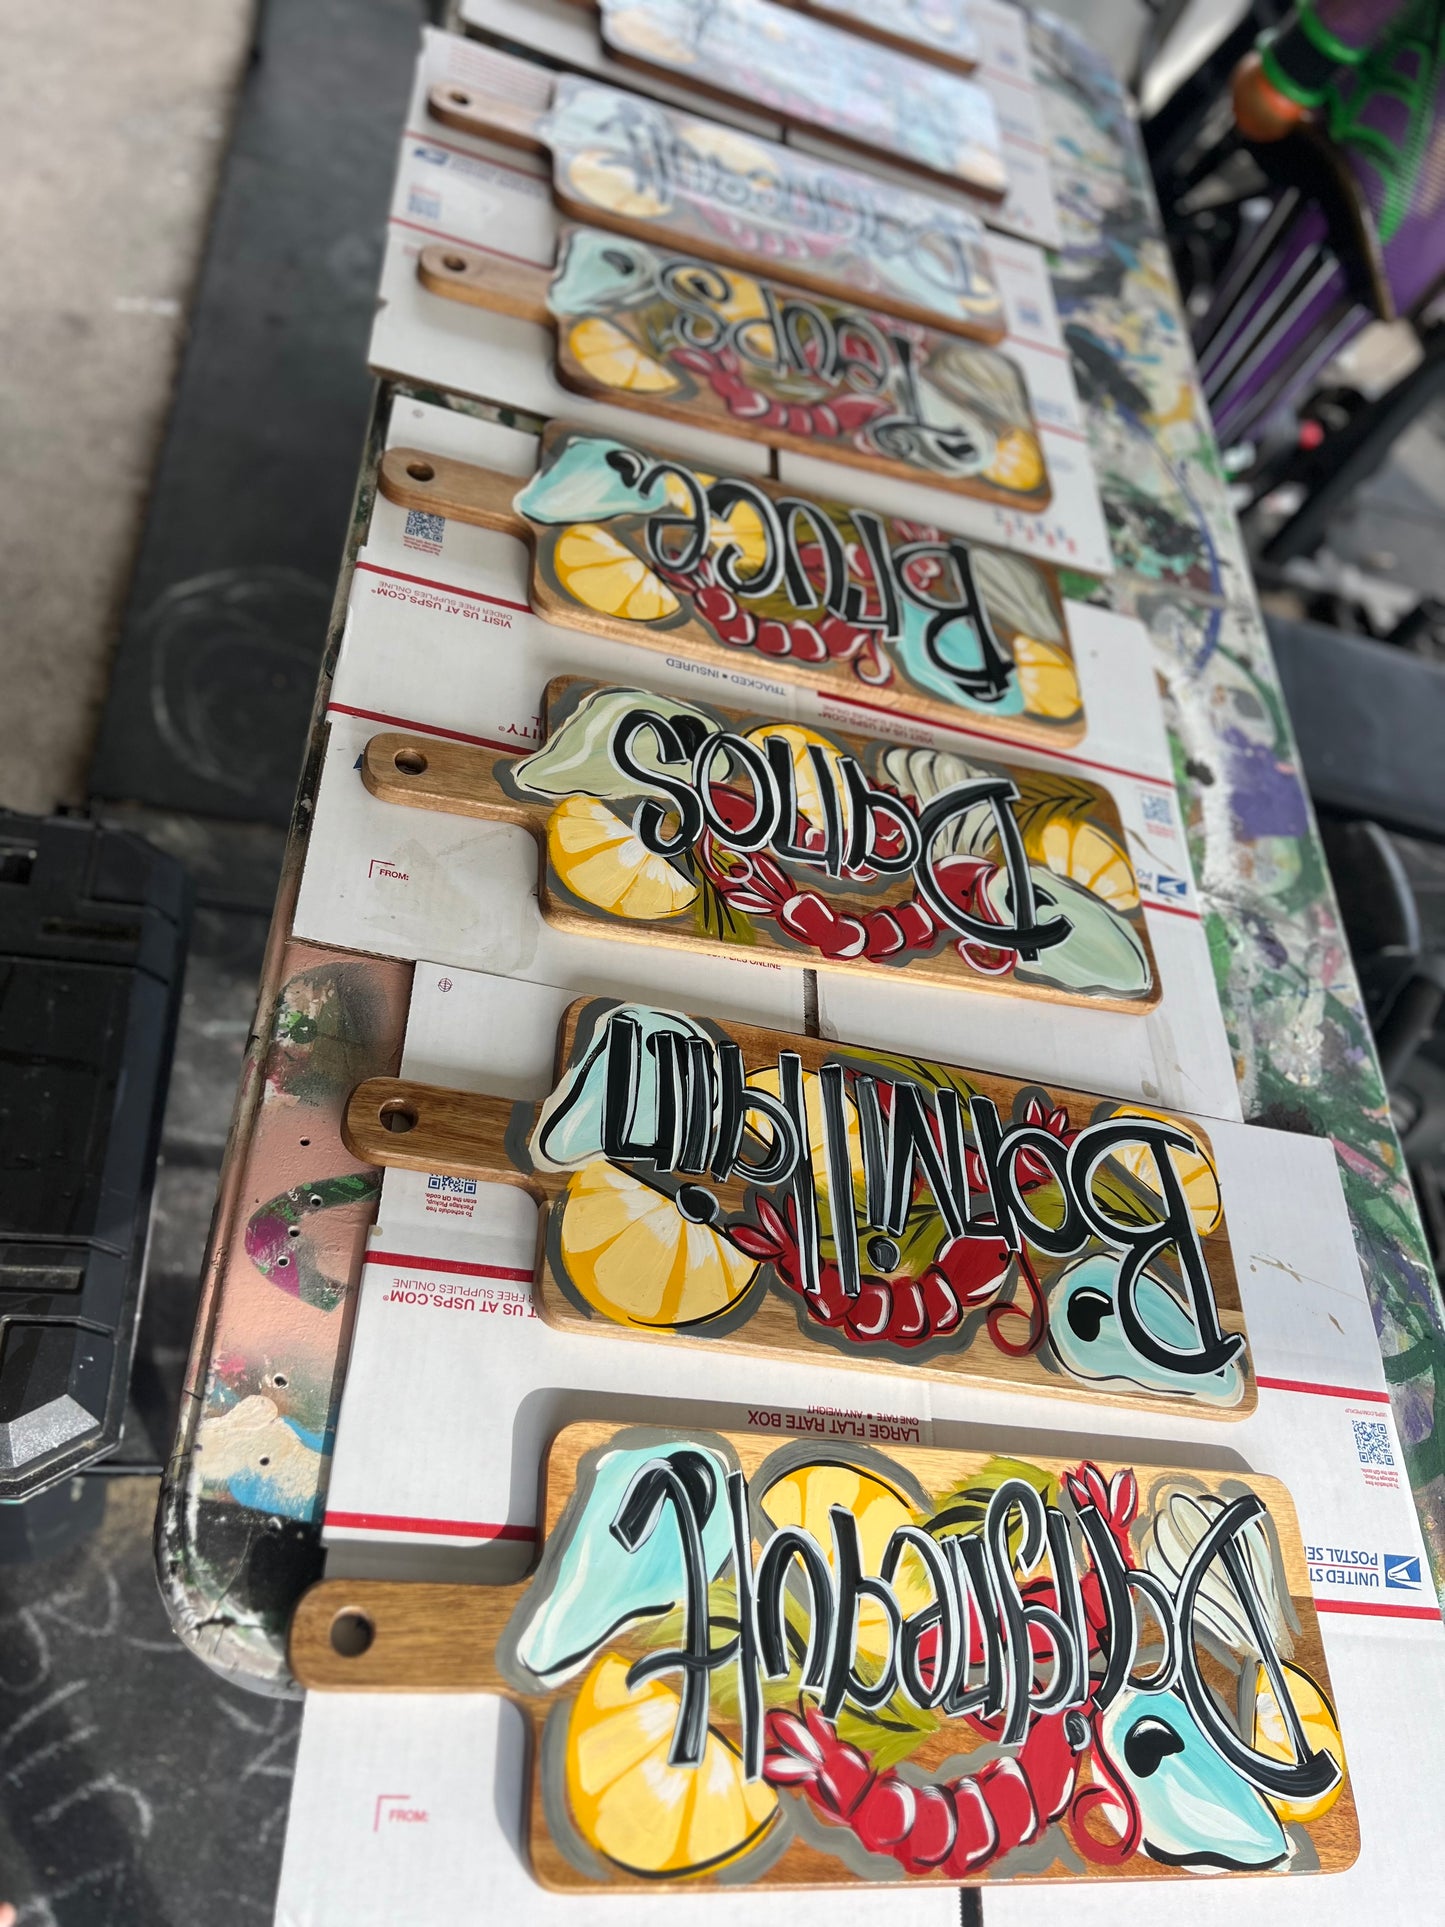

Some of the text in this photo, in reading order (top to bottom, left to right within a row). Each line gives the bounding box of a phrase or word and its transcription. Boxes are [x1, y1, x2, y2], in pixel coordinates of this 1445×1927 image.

[637, 459, 1016, 706] Bruce
[378, 581, 512, 621] ORDER FREE SUPPLIES ONLINE
[445, 606, 460, 615] AT
[463, 610, 479, 620] US
[482, 615, 512, 629] VISIT
[665, 658, 786, 696] TRACKED INSURED
[879, 726, 890, 735] AT
[893, 729, 908, 739] US
[910, 734, 934, 746] VISIT
[611, 710, 1072, 962] Danos
[380, 869, 409, 881] FROM:
[599, 1013, 1246, 1378] Bonvillain
[438, 1208, 464, 1216] schedule
[449, 1202, 474, 1211] Package
[392, 1278, 436, 1292] ONLINE
[439, 1284, 494, 1299] SUPPLIES
[497, 1290, 525, 1302] FREE
[479, 1301, 499, 1313] AT
[503, 1303, 523, 1316] US
[807, 1405, 919, 1426] ONE RATE ANY WEIGHT
[748, 1410, 920, 1443] LARGE FLAT RATE BOX
[1304, 1546, 1378, 1565] POSTAL SE
[1326, 1570, 1379, 1587] UNITED
[609, 1457, 1340, 1801] Daigneault
